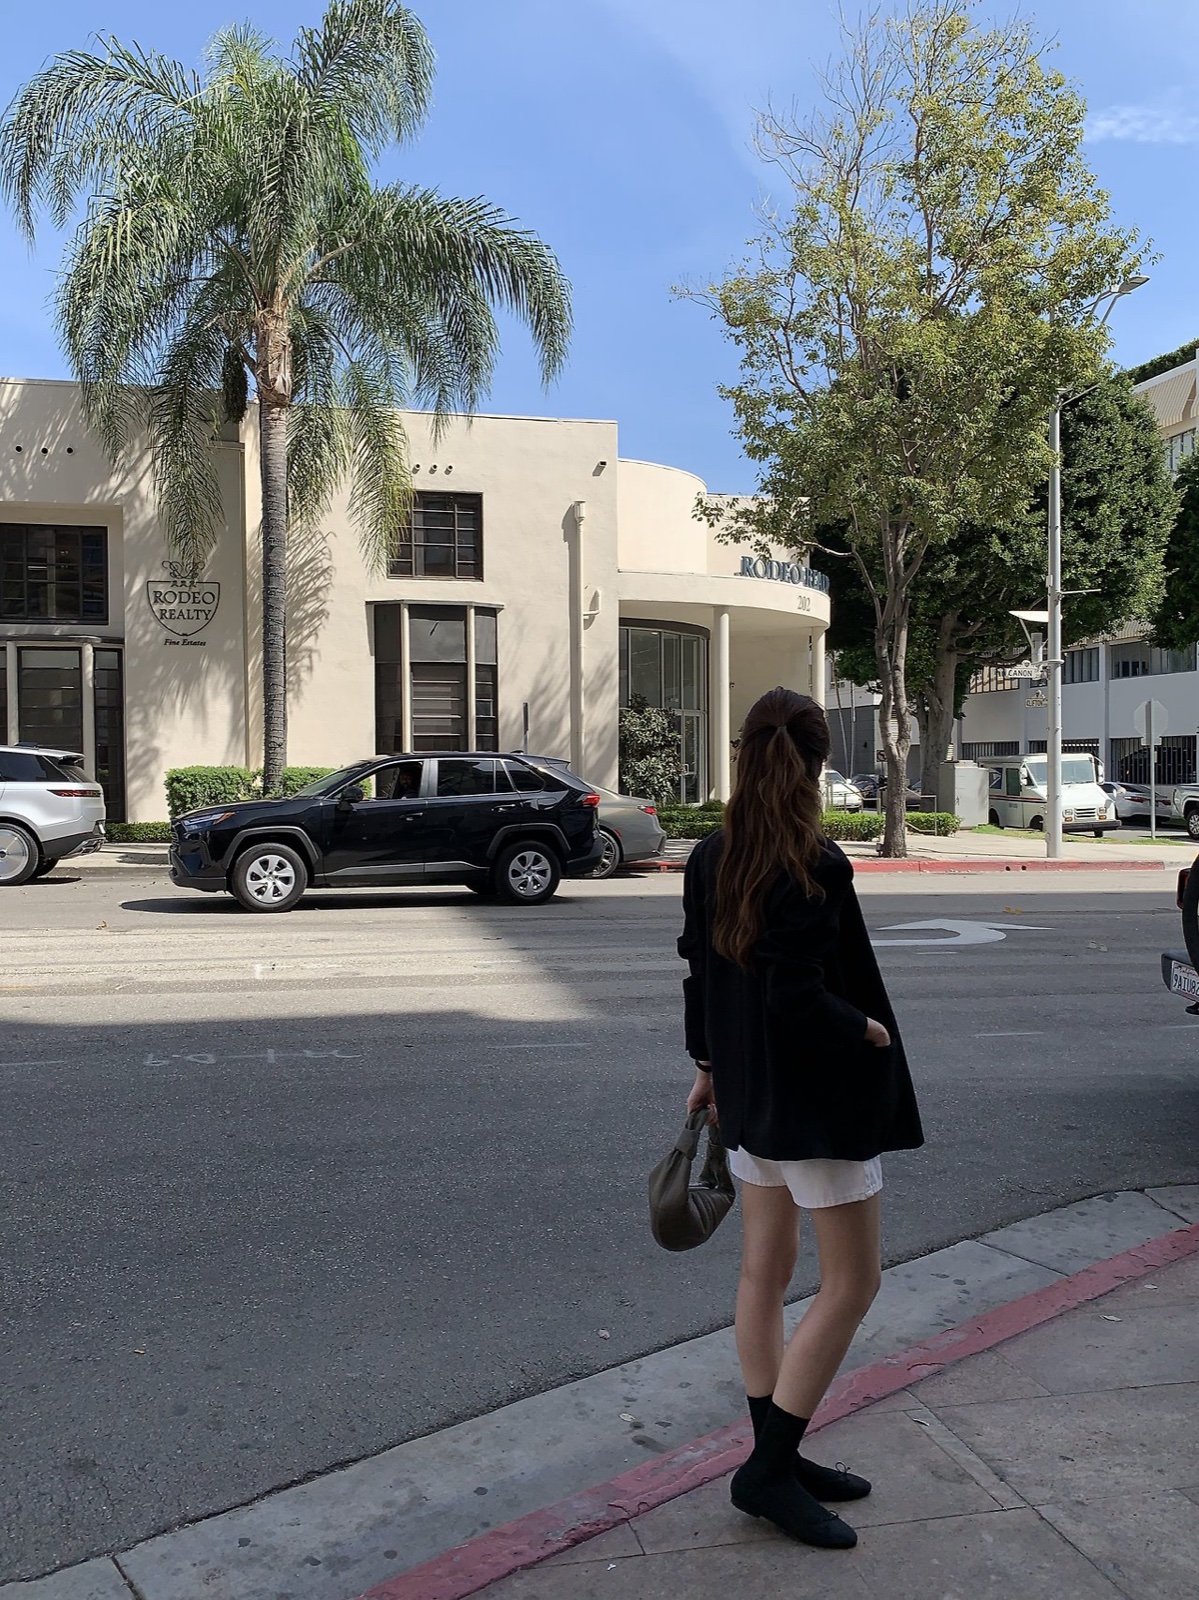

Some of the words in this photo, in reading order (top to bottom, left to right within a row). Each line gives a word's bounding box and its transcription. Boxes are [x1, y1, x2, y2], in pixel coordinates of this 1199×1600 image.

[741, 556, 801, 585] RODEO
[153, 590, 215, 605] RODEO
[797, 595, 811, 612] 202
[160, 608, 212, 620] REALTY
[181, 639, 207, 647] Estates
[1008, 669, 1033, 677] CANON
